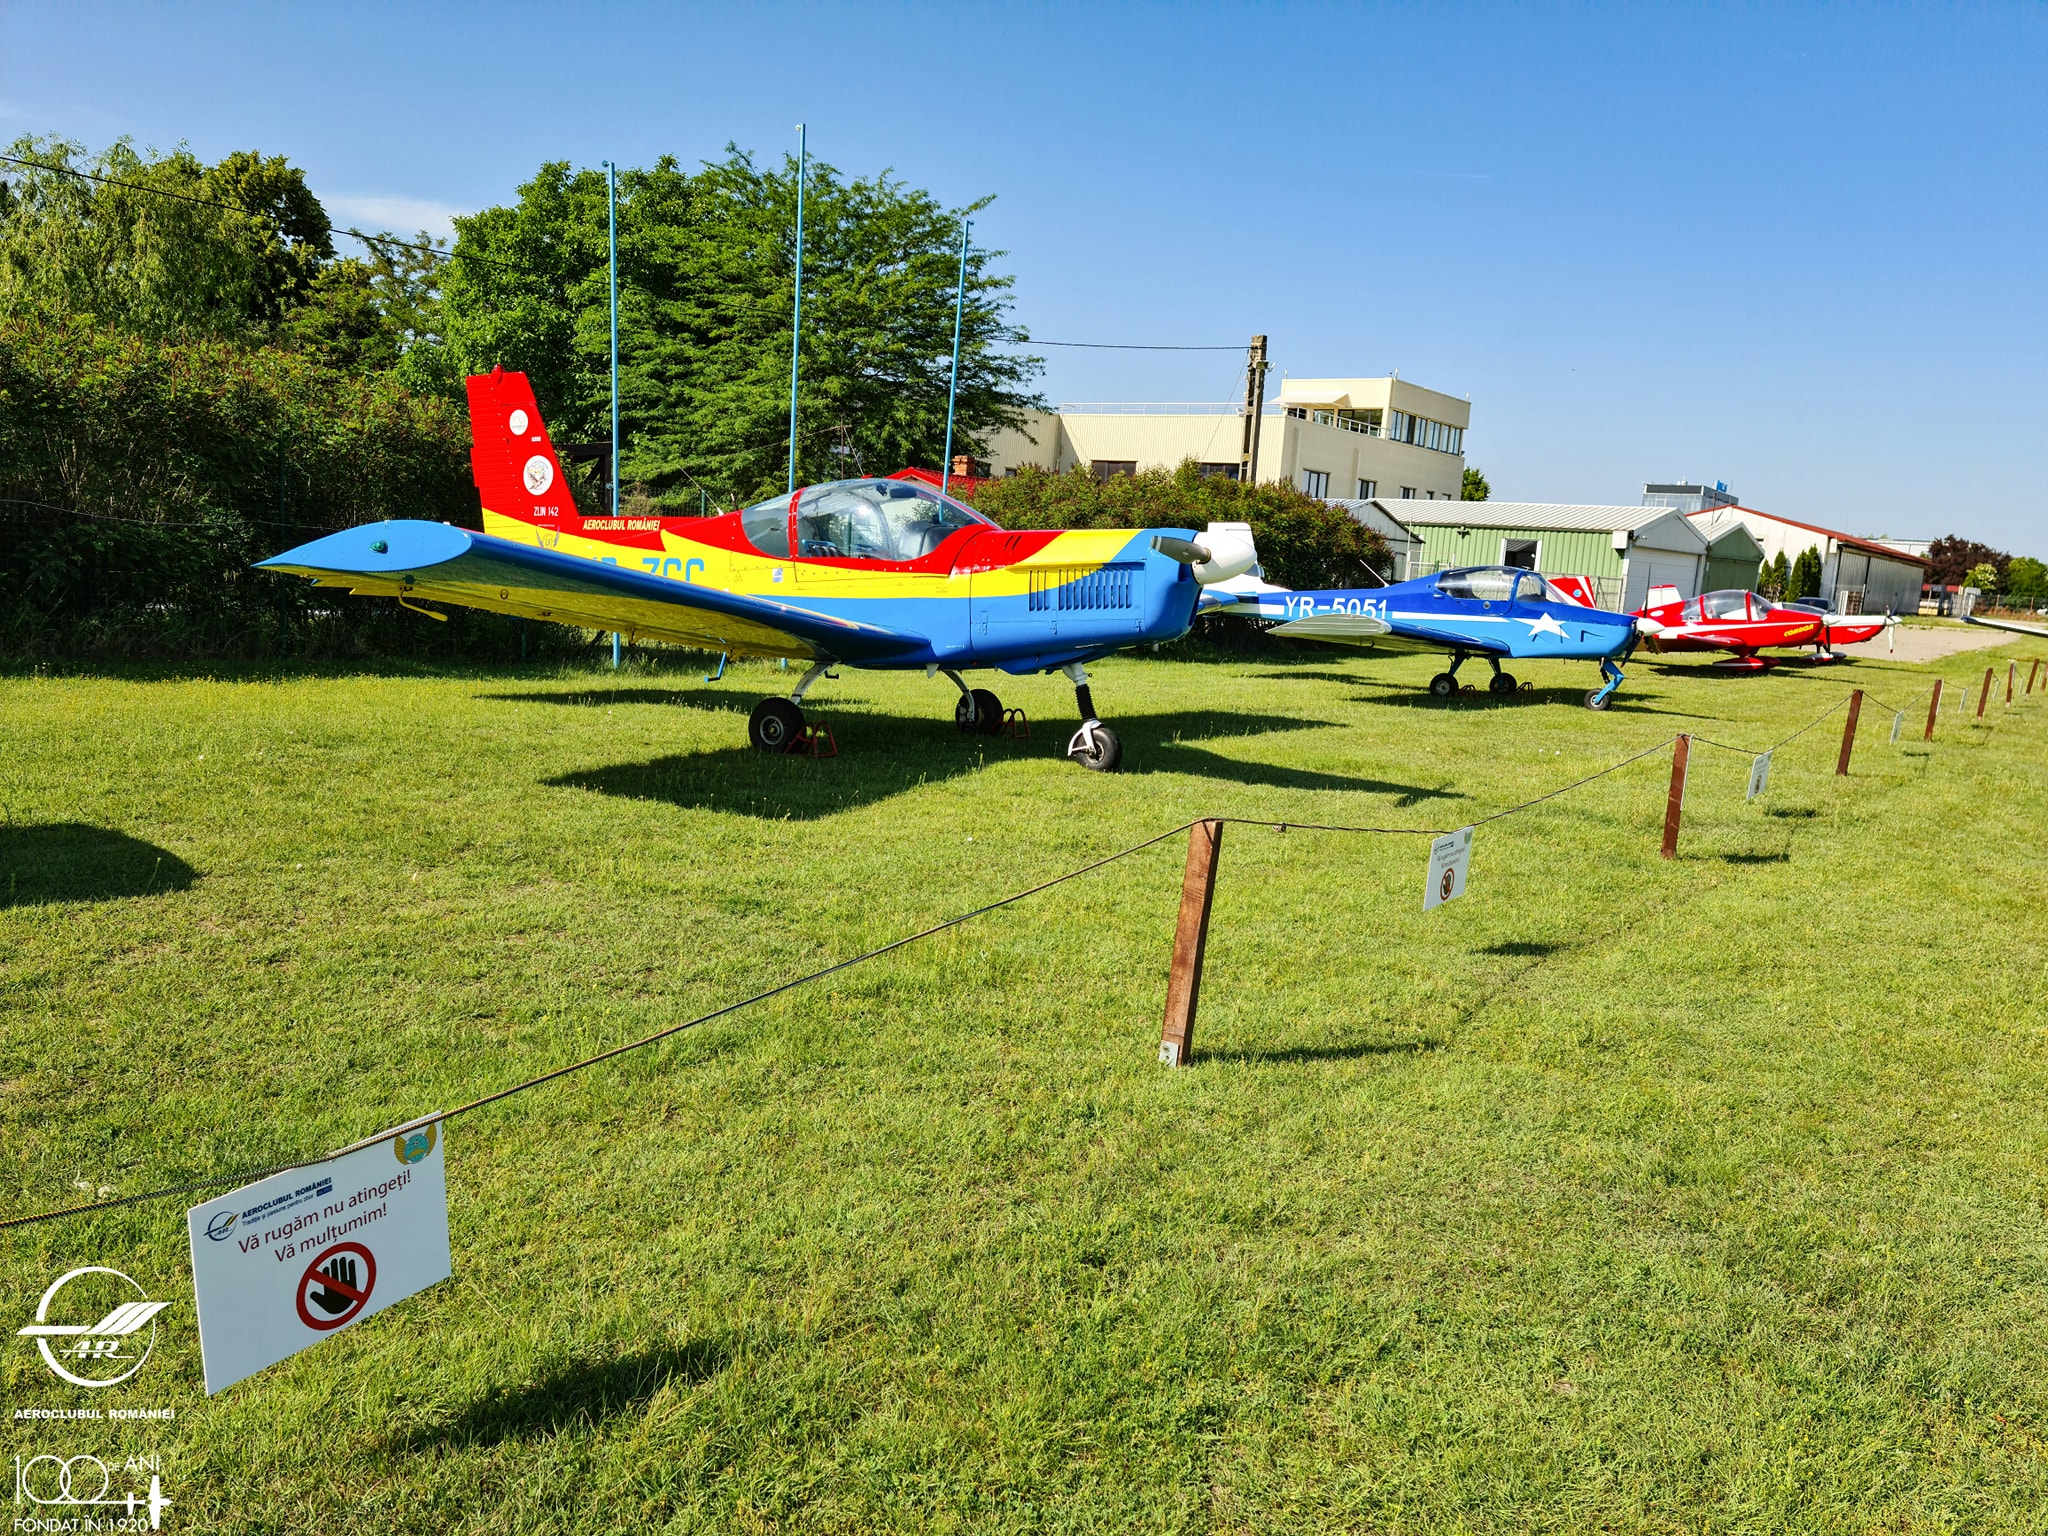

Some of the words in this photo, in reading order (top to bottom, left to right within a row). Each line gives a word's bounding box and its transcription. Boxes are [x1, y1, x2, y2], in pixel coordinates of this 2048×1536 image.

[533, 507, 546, 516] ZLIN
[548, 506, 559, 516] 142
[583, 520, 625, 531] AEROCLUBUL
[1285, 596, 1387, 619] YR-5051
[1784, 624, 1814, 637] CONDOR
[241, 1193, 294, 1219] AEROCLUBUL
[295, 1176, 332, 1198] ROMÂNIEI
[238, 1233, 260, 1254] Vă
[264, 1212, 319, 1240] rugăm
[323, 1201, 345, 1219] nu
[348, 1169, 412, 1208] atingeți!
[274, 1243, 296, 1263] Vă
[300, 1202, 387, 1243] mulțumim!
